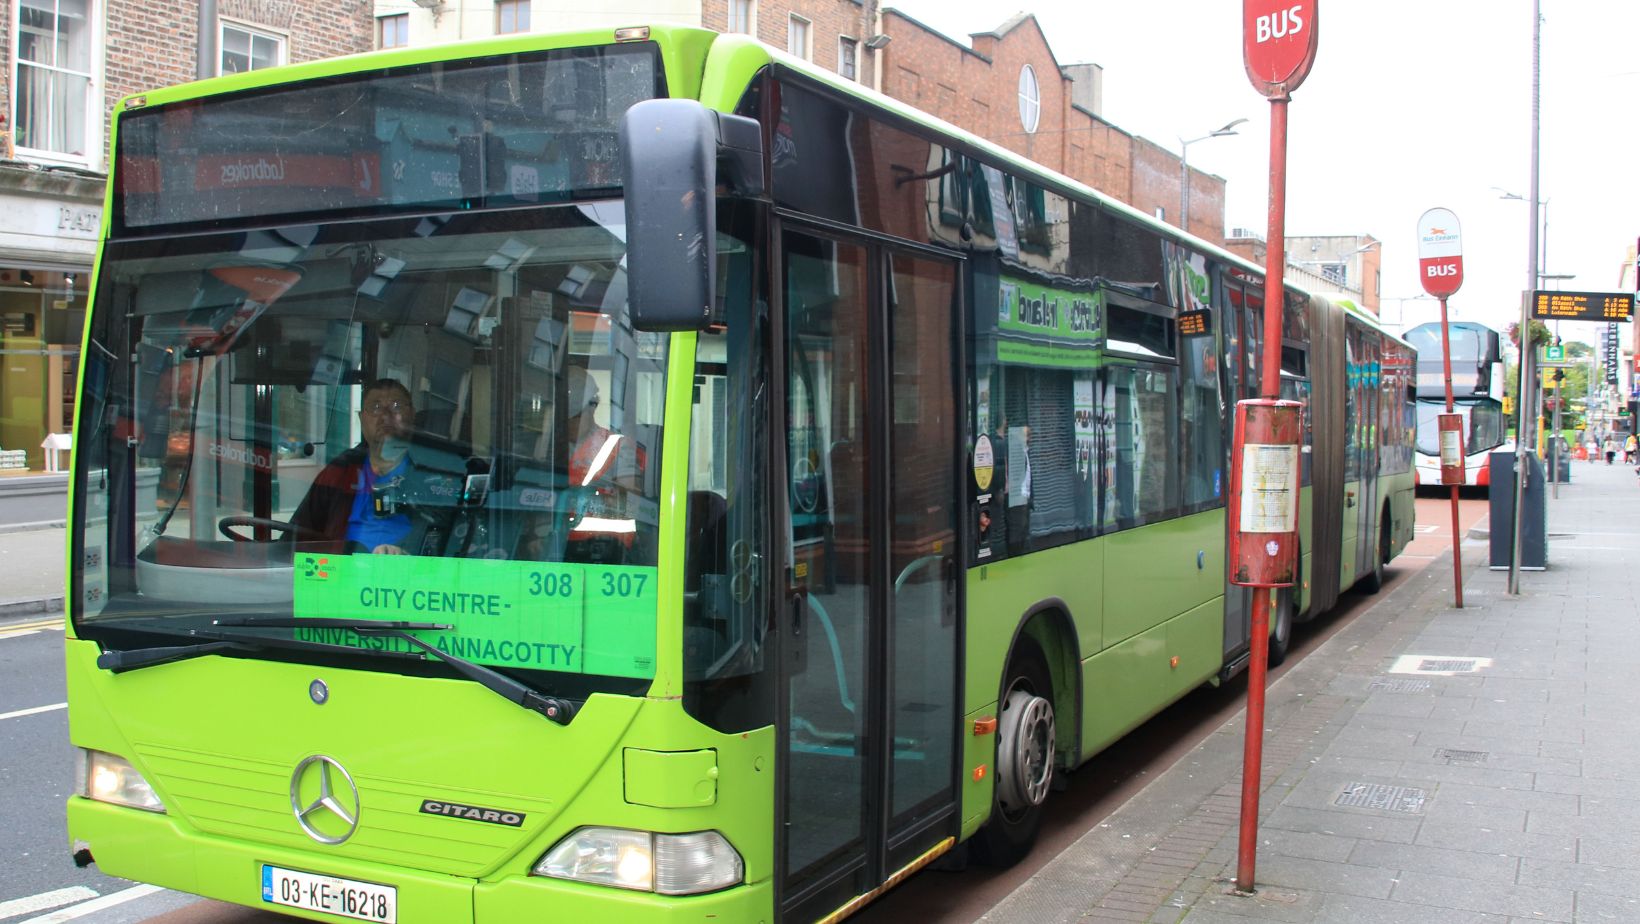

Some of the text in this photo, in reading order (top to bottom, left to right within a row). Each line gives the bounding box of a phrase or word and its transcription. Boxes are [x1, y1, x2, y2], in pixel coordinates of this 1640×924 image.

[1256, 5, 1303, 43] BUS
[1427, 263, 1457, 277] BUS
[1607, 322, 1617, 380] DEBENHAMS
[360, 587, 406, 609] CITY
[528, 571, 573, 598] 308
[601, 571, 648, 598] 307
[438, 635, 576, 666] ANNACOTTY
[424, 802, 520, 824] CITARO
[281, 877, 387, 919] 03-KE-16218
